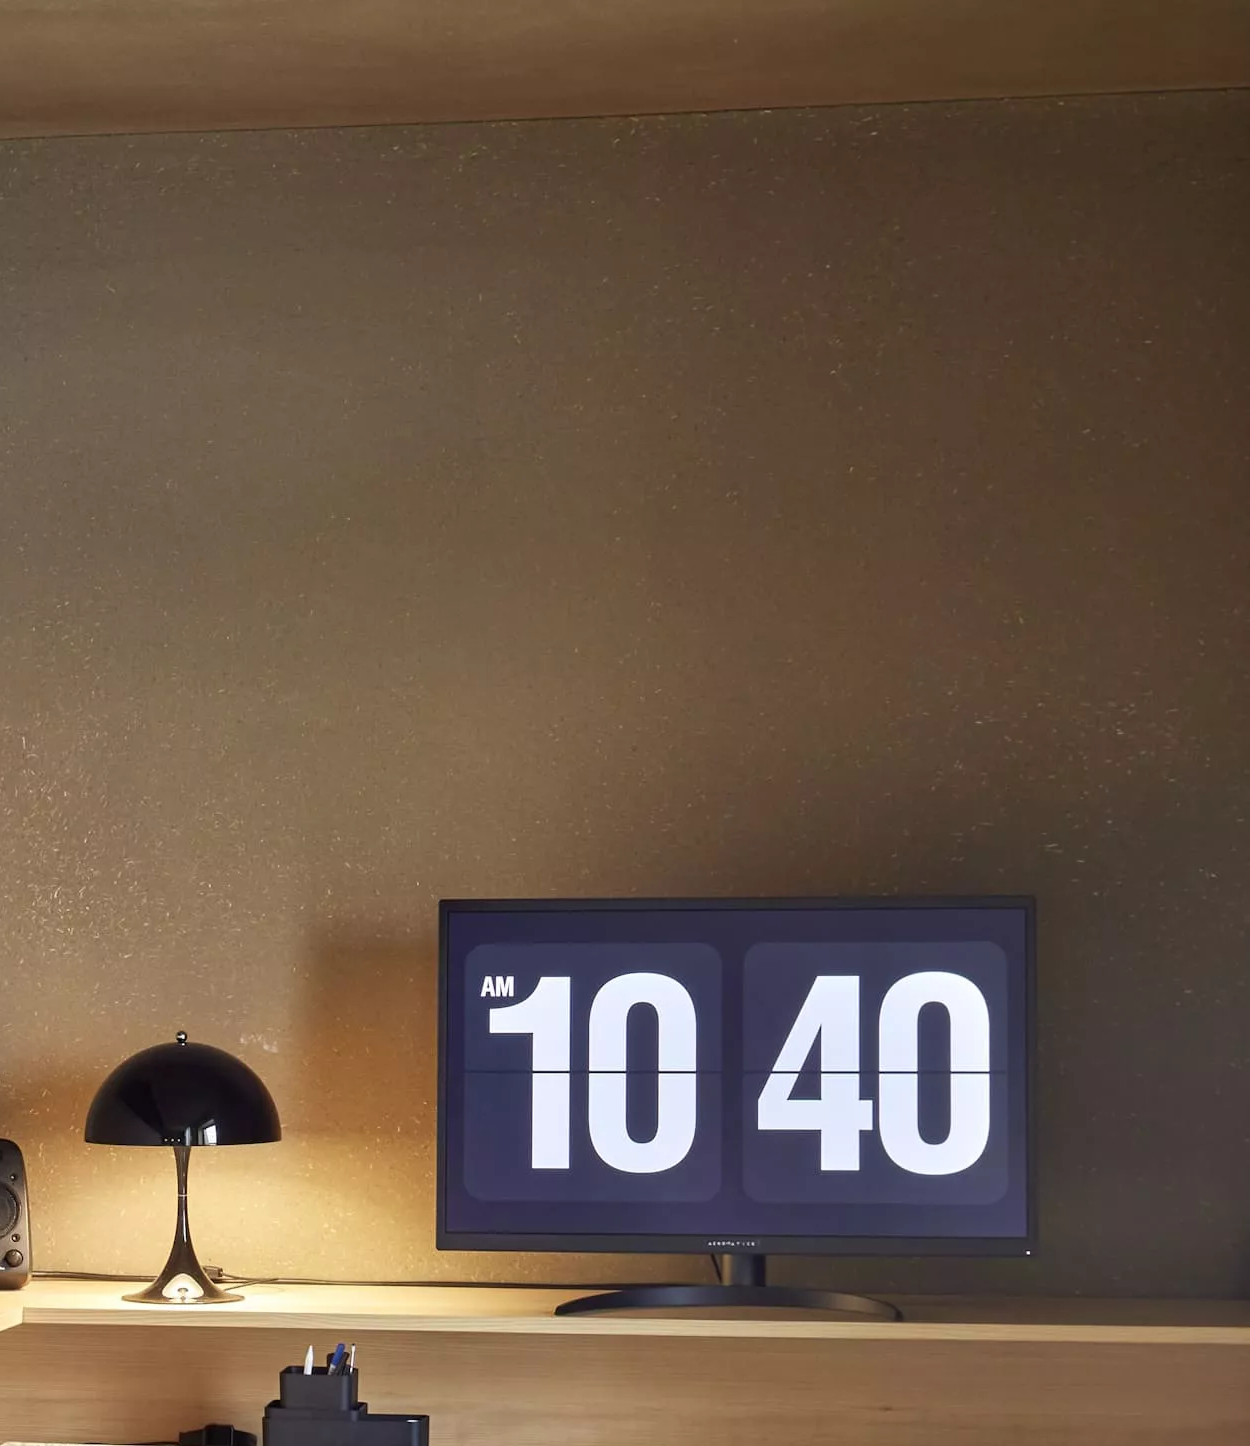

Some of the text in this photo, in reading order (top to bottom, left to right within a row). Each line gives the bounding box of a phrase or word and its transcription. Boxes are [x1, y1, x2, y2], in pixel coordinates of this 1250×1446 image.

[481, 976, 515, 998] AM
[489, 971, 991, 1176] 10 40
